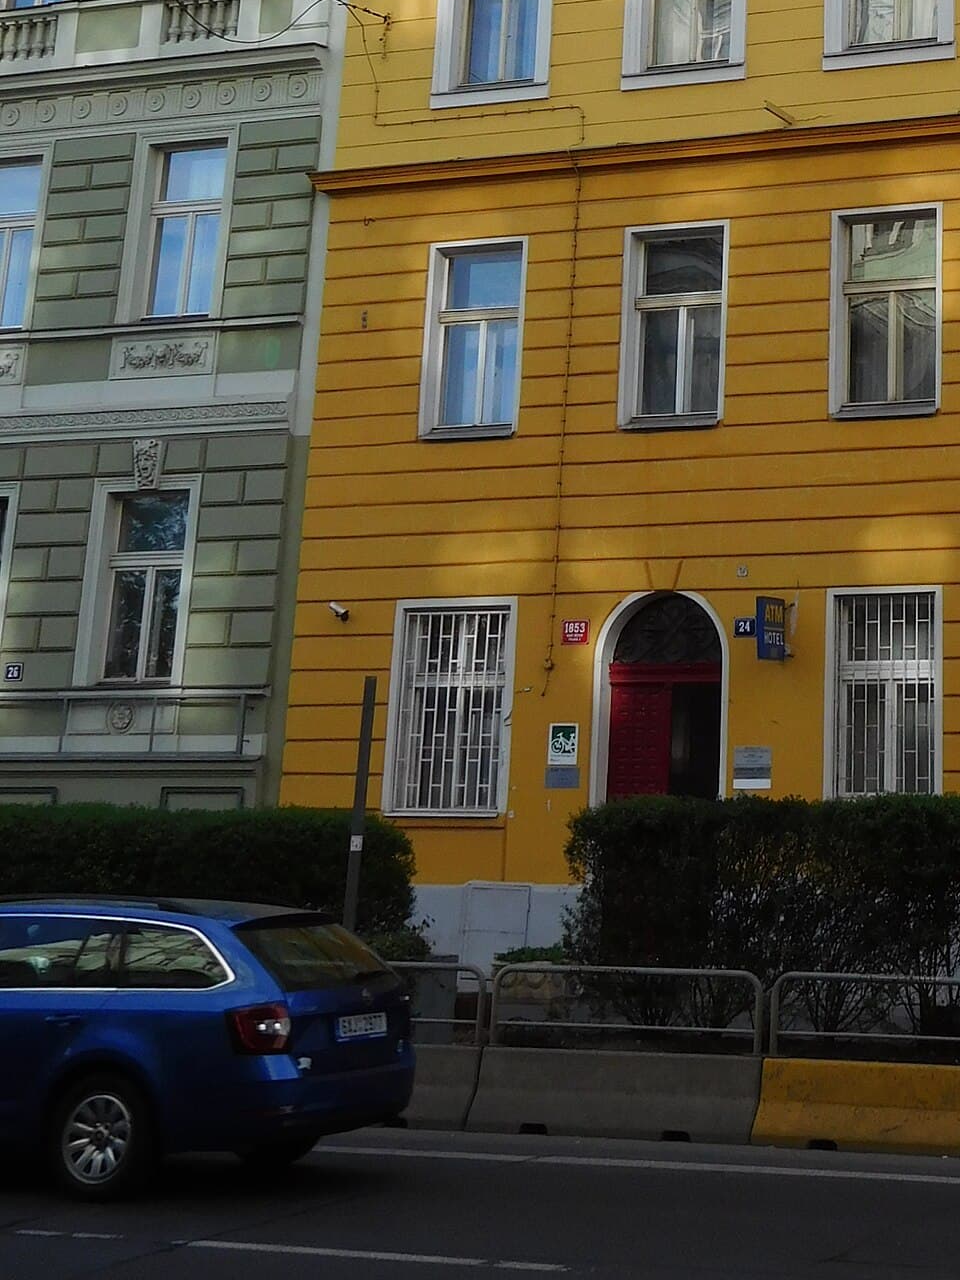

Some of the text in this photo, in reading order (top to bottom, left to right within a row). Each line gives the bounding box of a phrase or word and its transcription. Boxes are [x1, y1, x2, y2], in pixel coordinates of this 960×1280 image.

[764, 604, 784, 624] ATM
[564, 622, 586, 634] 1853
[738, 621, 751, 632] 24
[764, 631, 784, 646] HOTEL
[7, 666, 19, 678] 26
